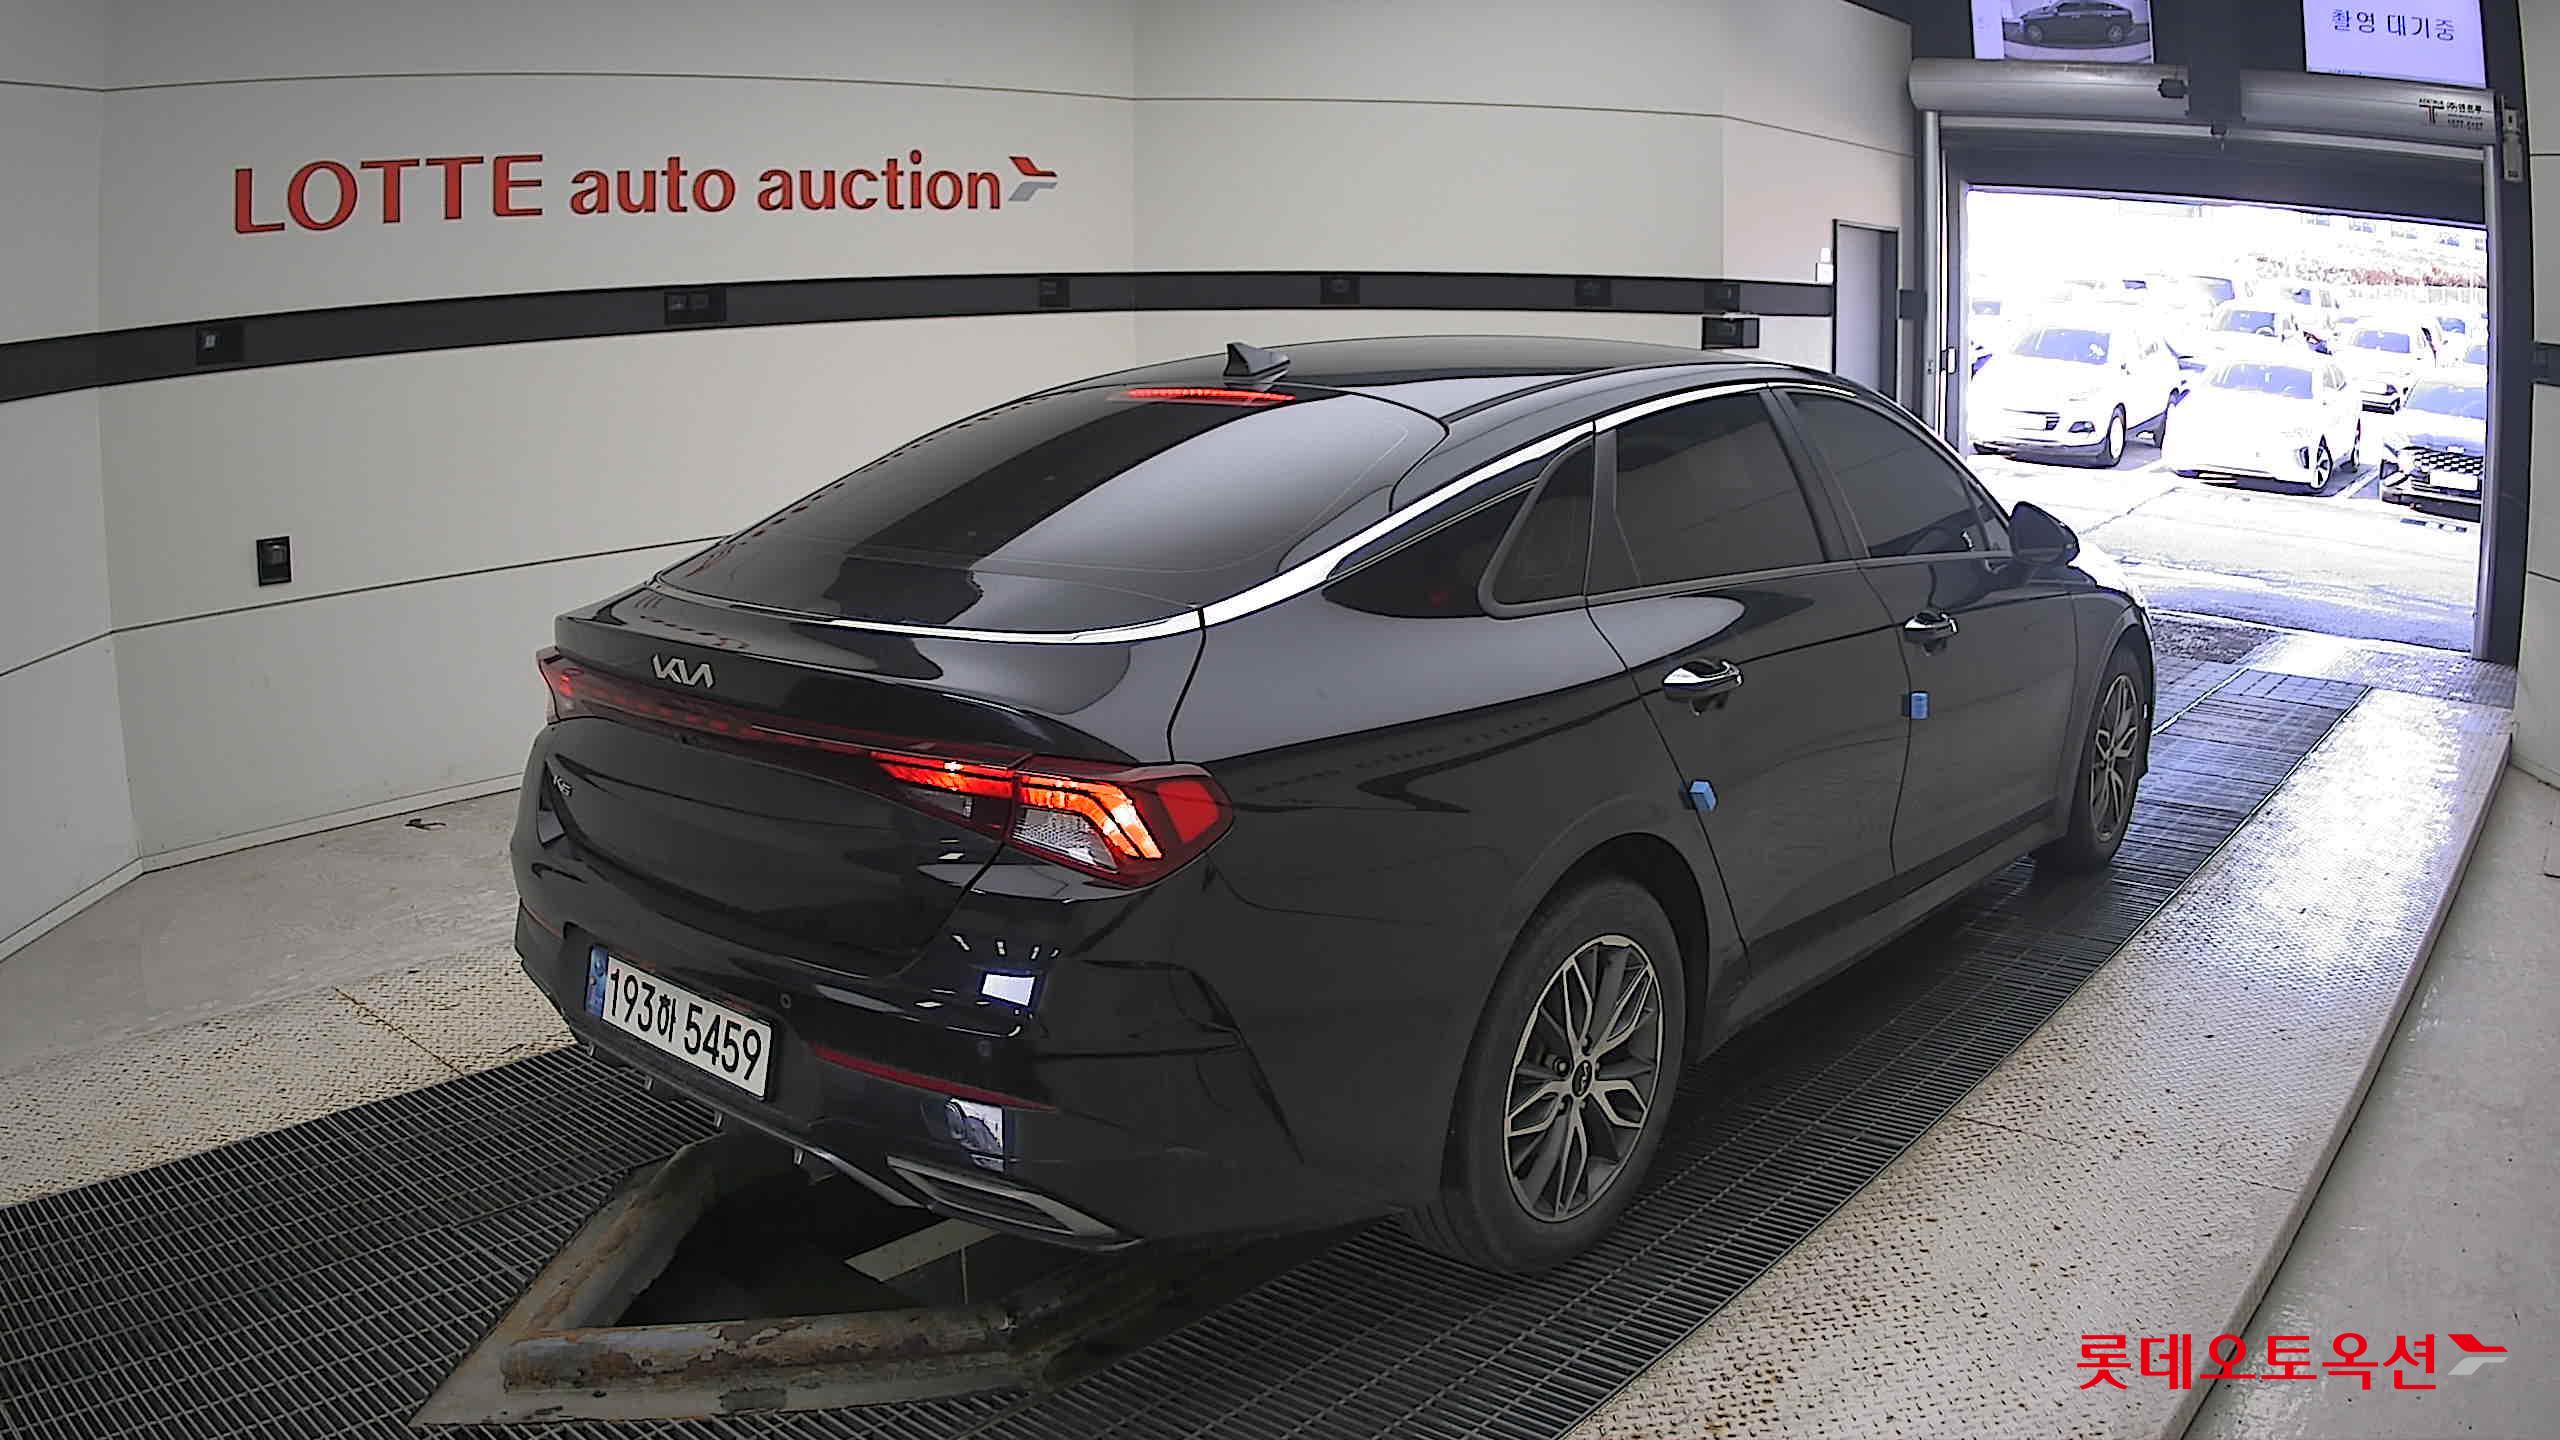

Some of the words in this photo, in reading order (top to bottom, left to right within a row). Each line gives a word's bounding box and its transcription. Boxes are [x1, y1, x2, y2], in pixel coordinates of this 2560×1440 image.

[2332, 9, 2375, 34] 촬영
[2387, 14, 2454, 41] 대기중
[235, 154, 543, 234] LOTTE
[570, 156, 737, 215] auto
[757, 150, 1000, 211] auction
[652, 653, 714, 688] KIA
[610, 967, 677, 1043] 193하
[684, 1001, 762, 1081] 5459
